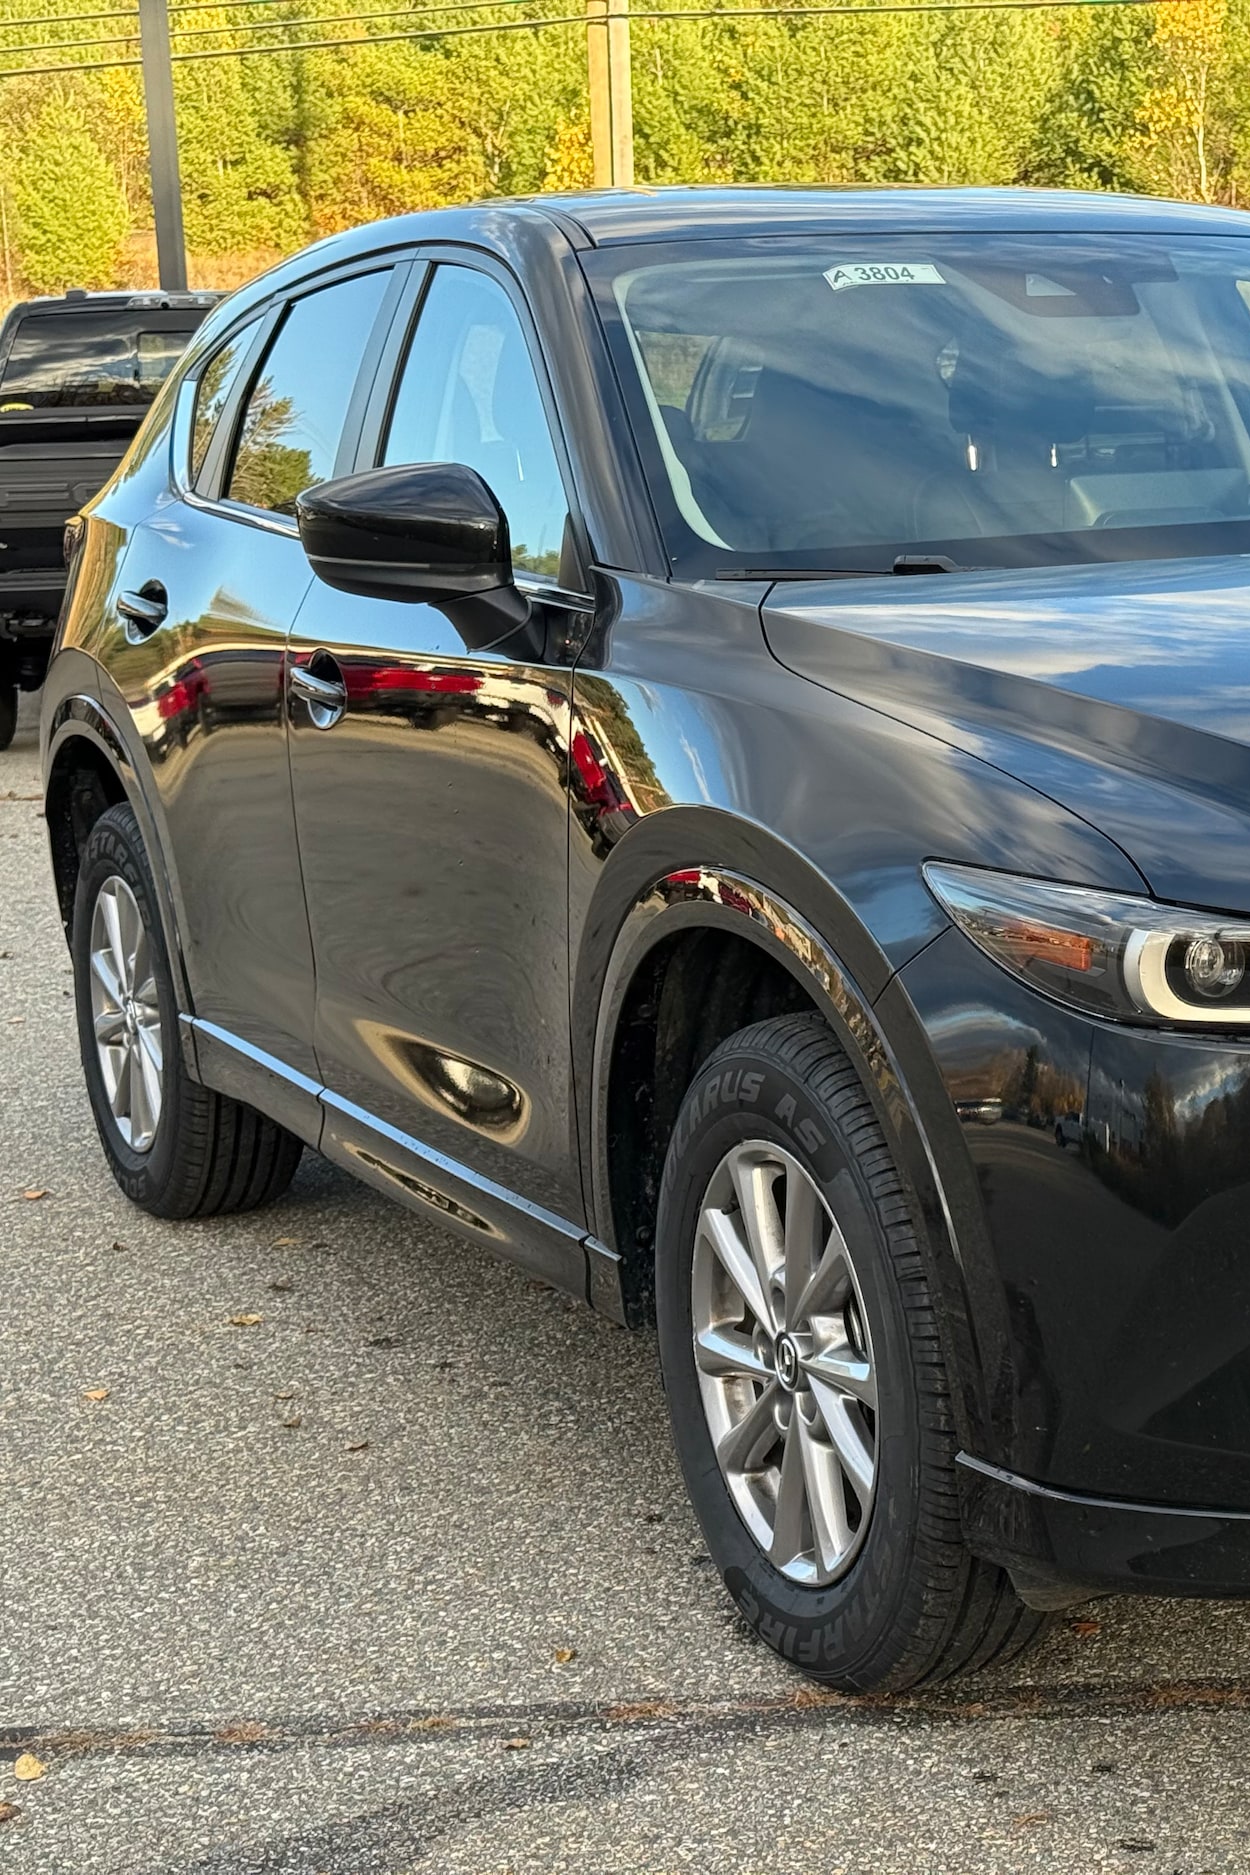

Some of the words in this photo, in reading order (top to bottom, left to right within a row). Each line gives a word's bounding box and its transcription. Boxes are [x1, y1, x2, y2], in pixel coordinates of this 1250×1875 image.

[833, 269, 853, 284] A
[854, 266, 916, 282] 3804
[774, 1093, 828, 1155] AS
